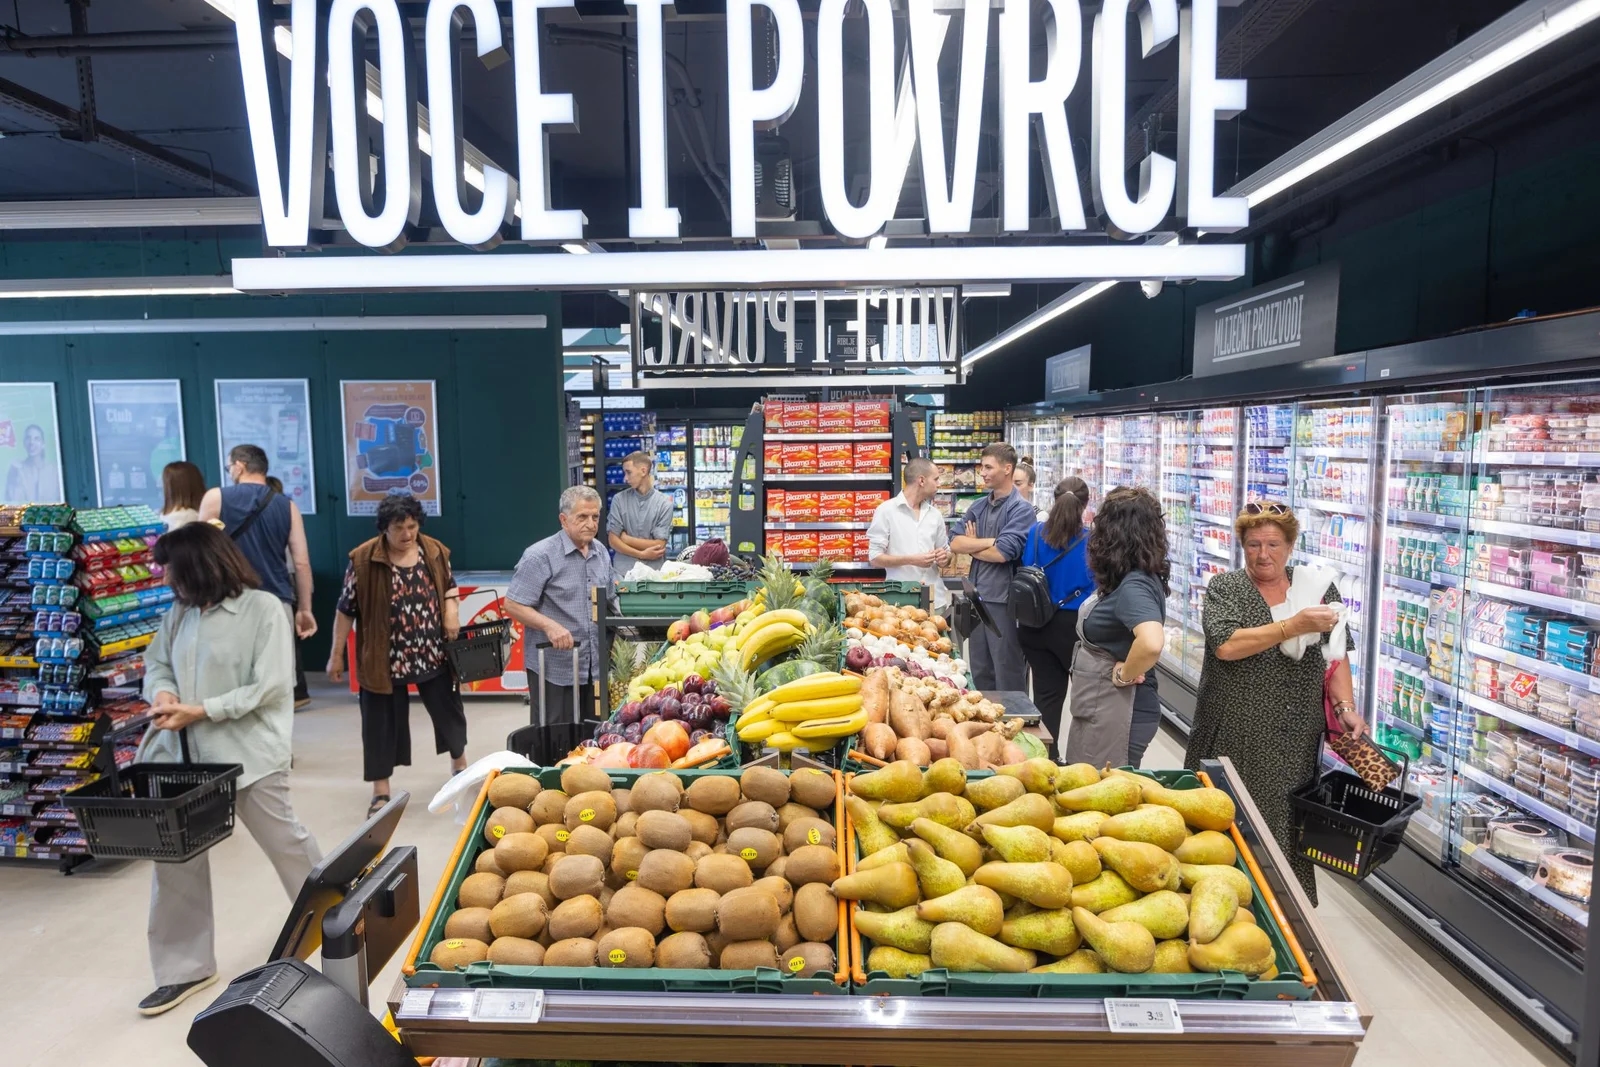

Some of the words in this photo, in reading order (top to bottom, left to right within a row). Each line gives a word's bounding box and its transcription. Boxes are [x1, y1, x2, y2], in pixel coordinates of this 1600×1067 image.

[628, 0, 681, 239] I
[1213, 306, 1252, 357] MLIJEČNI
[1251, 294, 1305, 349] PROIZVODI
